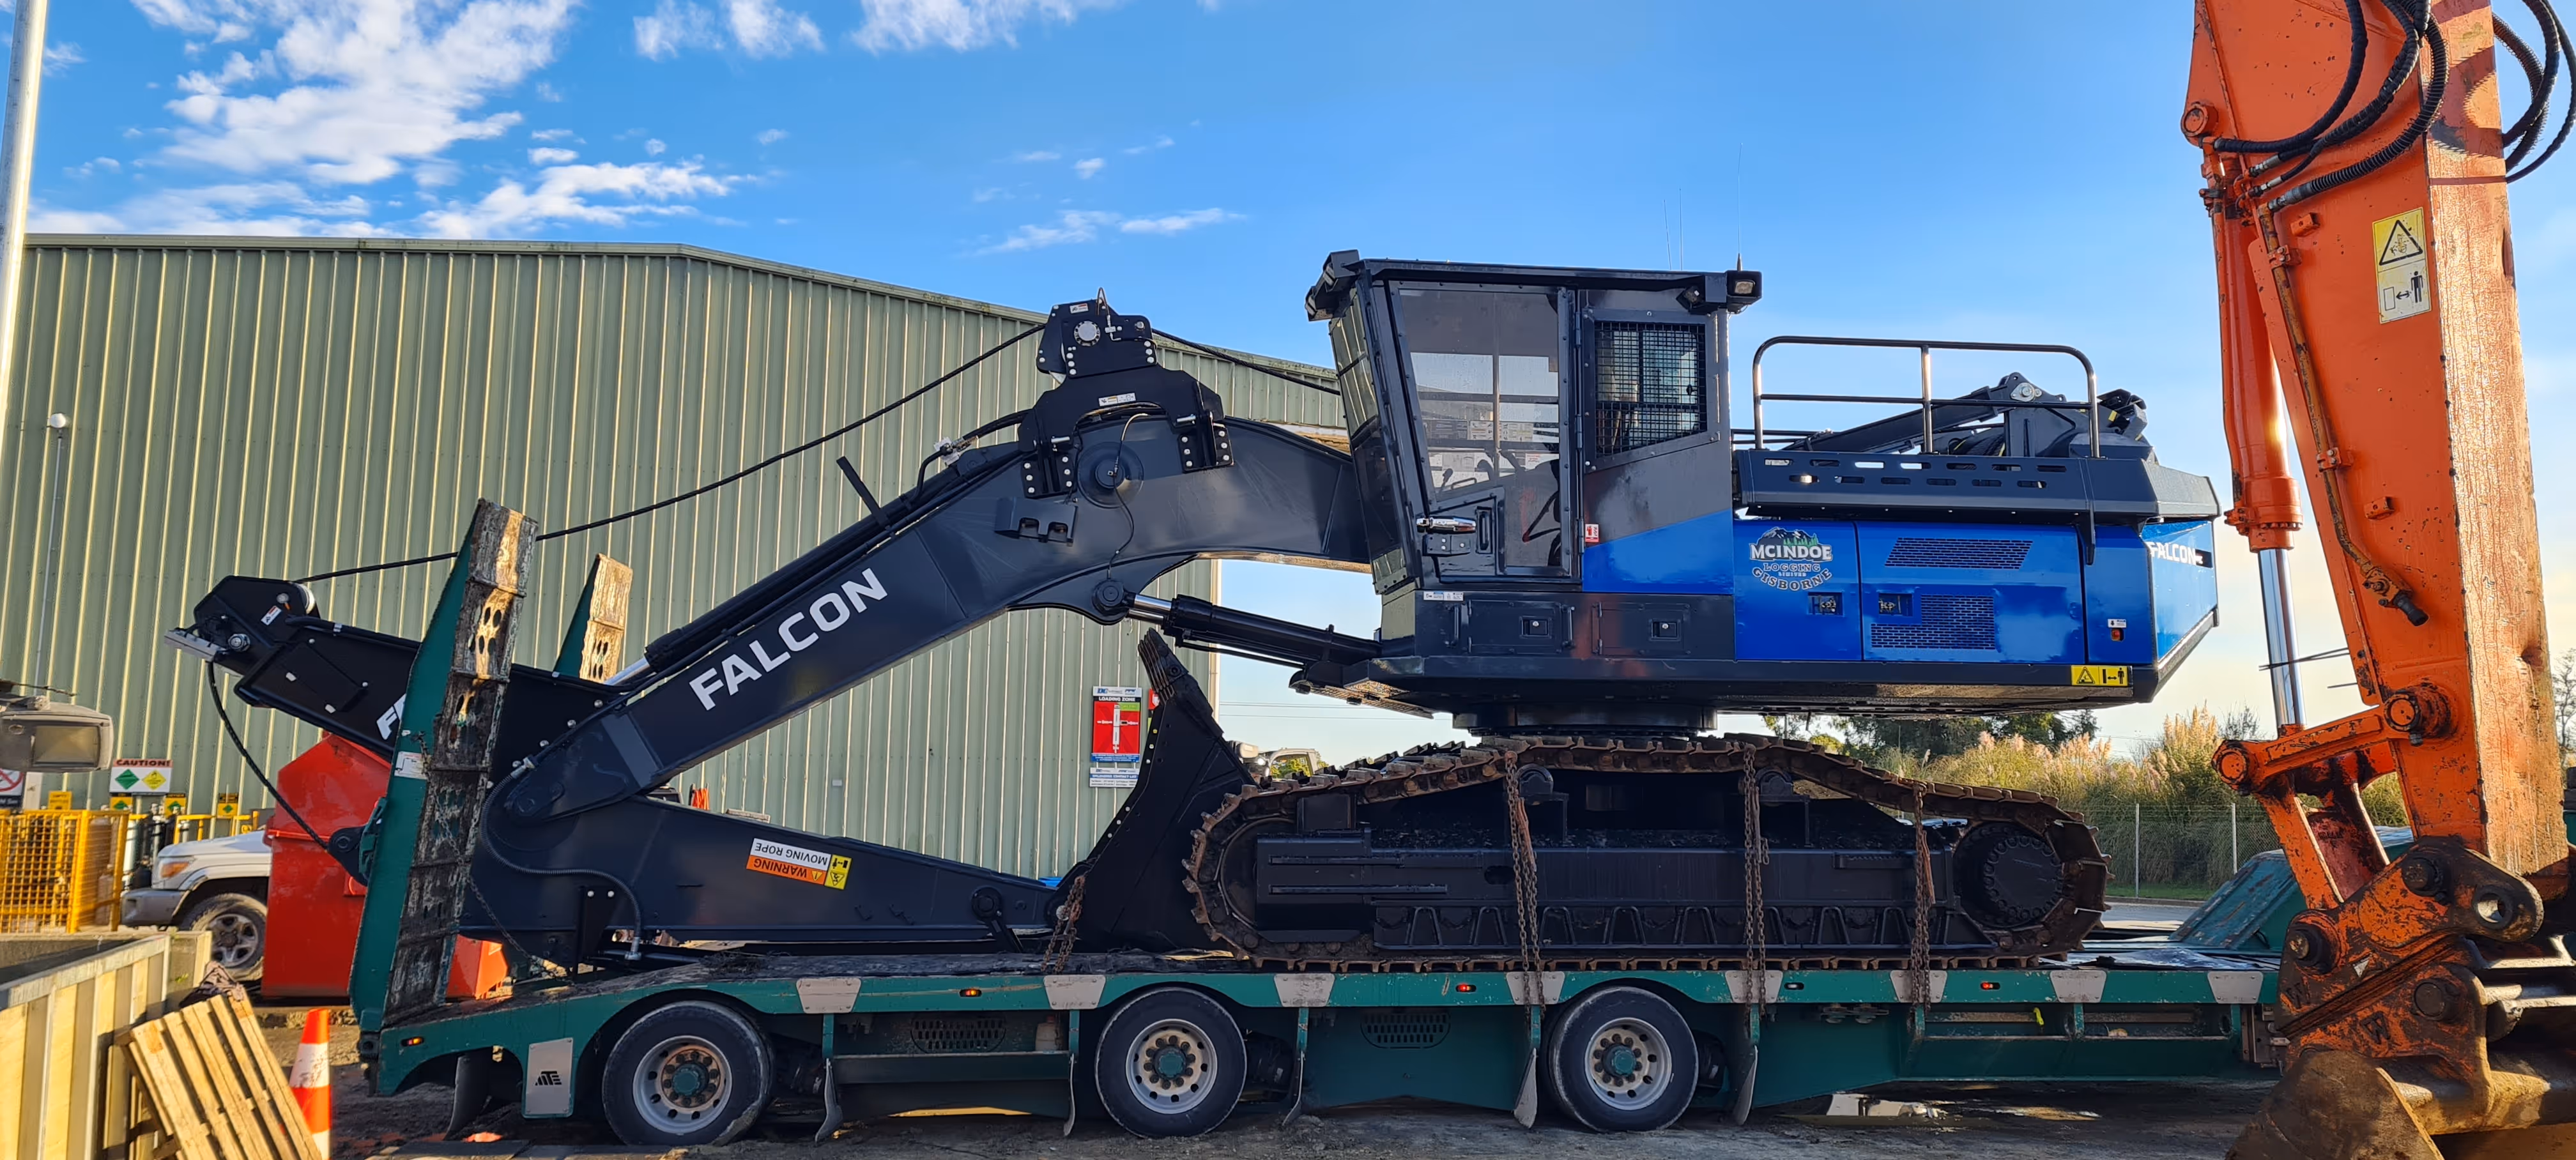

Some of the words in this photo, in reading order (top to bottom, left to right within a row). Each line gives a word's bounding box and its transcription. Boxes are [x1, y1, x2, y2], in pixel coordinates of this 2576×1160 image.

[1750, 544, 1832, 560] MCINDOE
[2145, 541, 2196, 565] FALCON
[1763, 563, 1820, 572] LOGGING
[1752, 567, 1832, 591] GISBORNE
[689, 568, 887, 711] FALCON
[755, 843, 783, 856] ROPE
[785, 849, 829, 866] MOVING
[753, 858, 808, 878] WARNING
